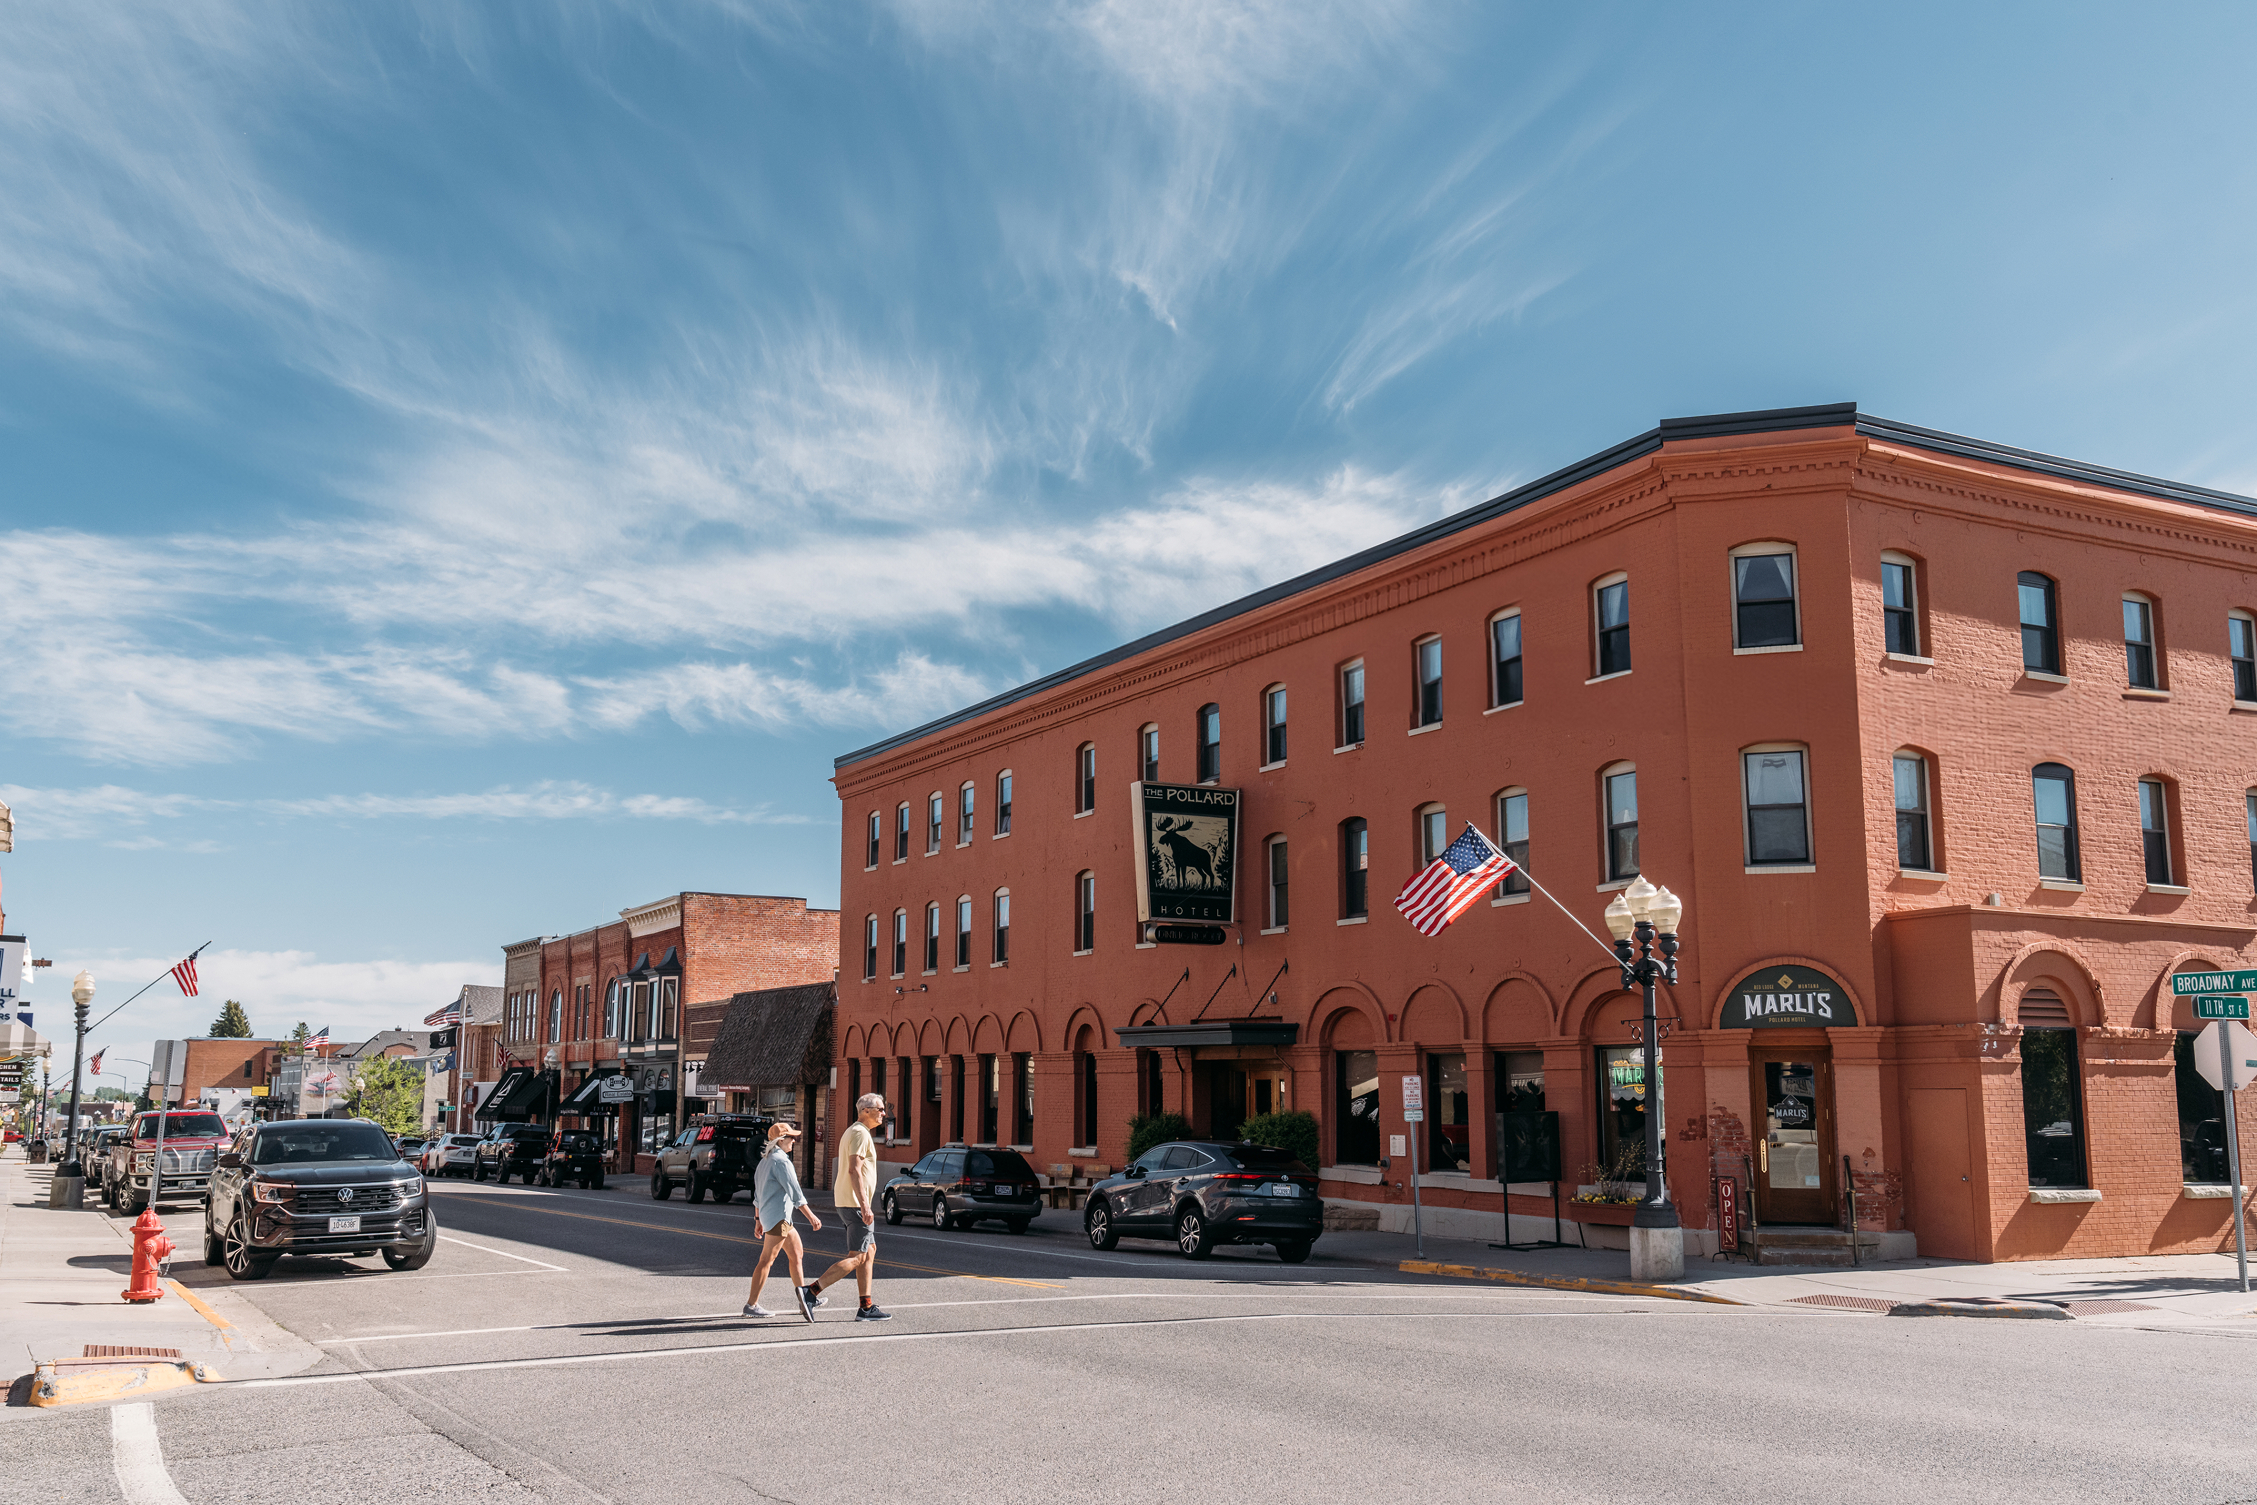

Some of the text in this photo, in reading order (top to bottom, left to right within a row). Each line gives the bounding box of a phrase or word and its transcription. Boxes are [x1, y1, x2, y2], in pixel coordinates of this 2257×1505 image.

[1145, 788, 1235, 806] THE POLLARD
[1160, 905, 1222, 917] HOTEL
[2177, 974, 2256, 992] BROADWAY AVE
[1743, 992, 1833, 1021] MARLI'S
[2228, 1004, 2235, 1015] ST
[2238, 1004, 2243, 1016] E
[1775, 1108, 1807, 1119] MARLI'S
[1721, 1184, 1733, 1243] OPEN
